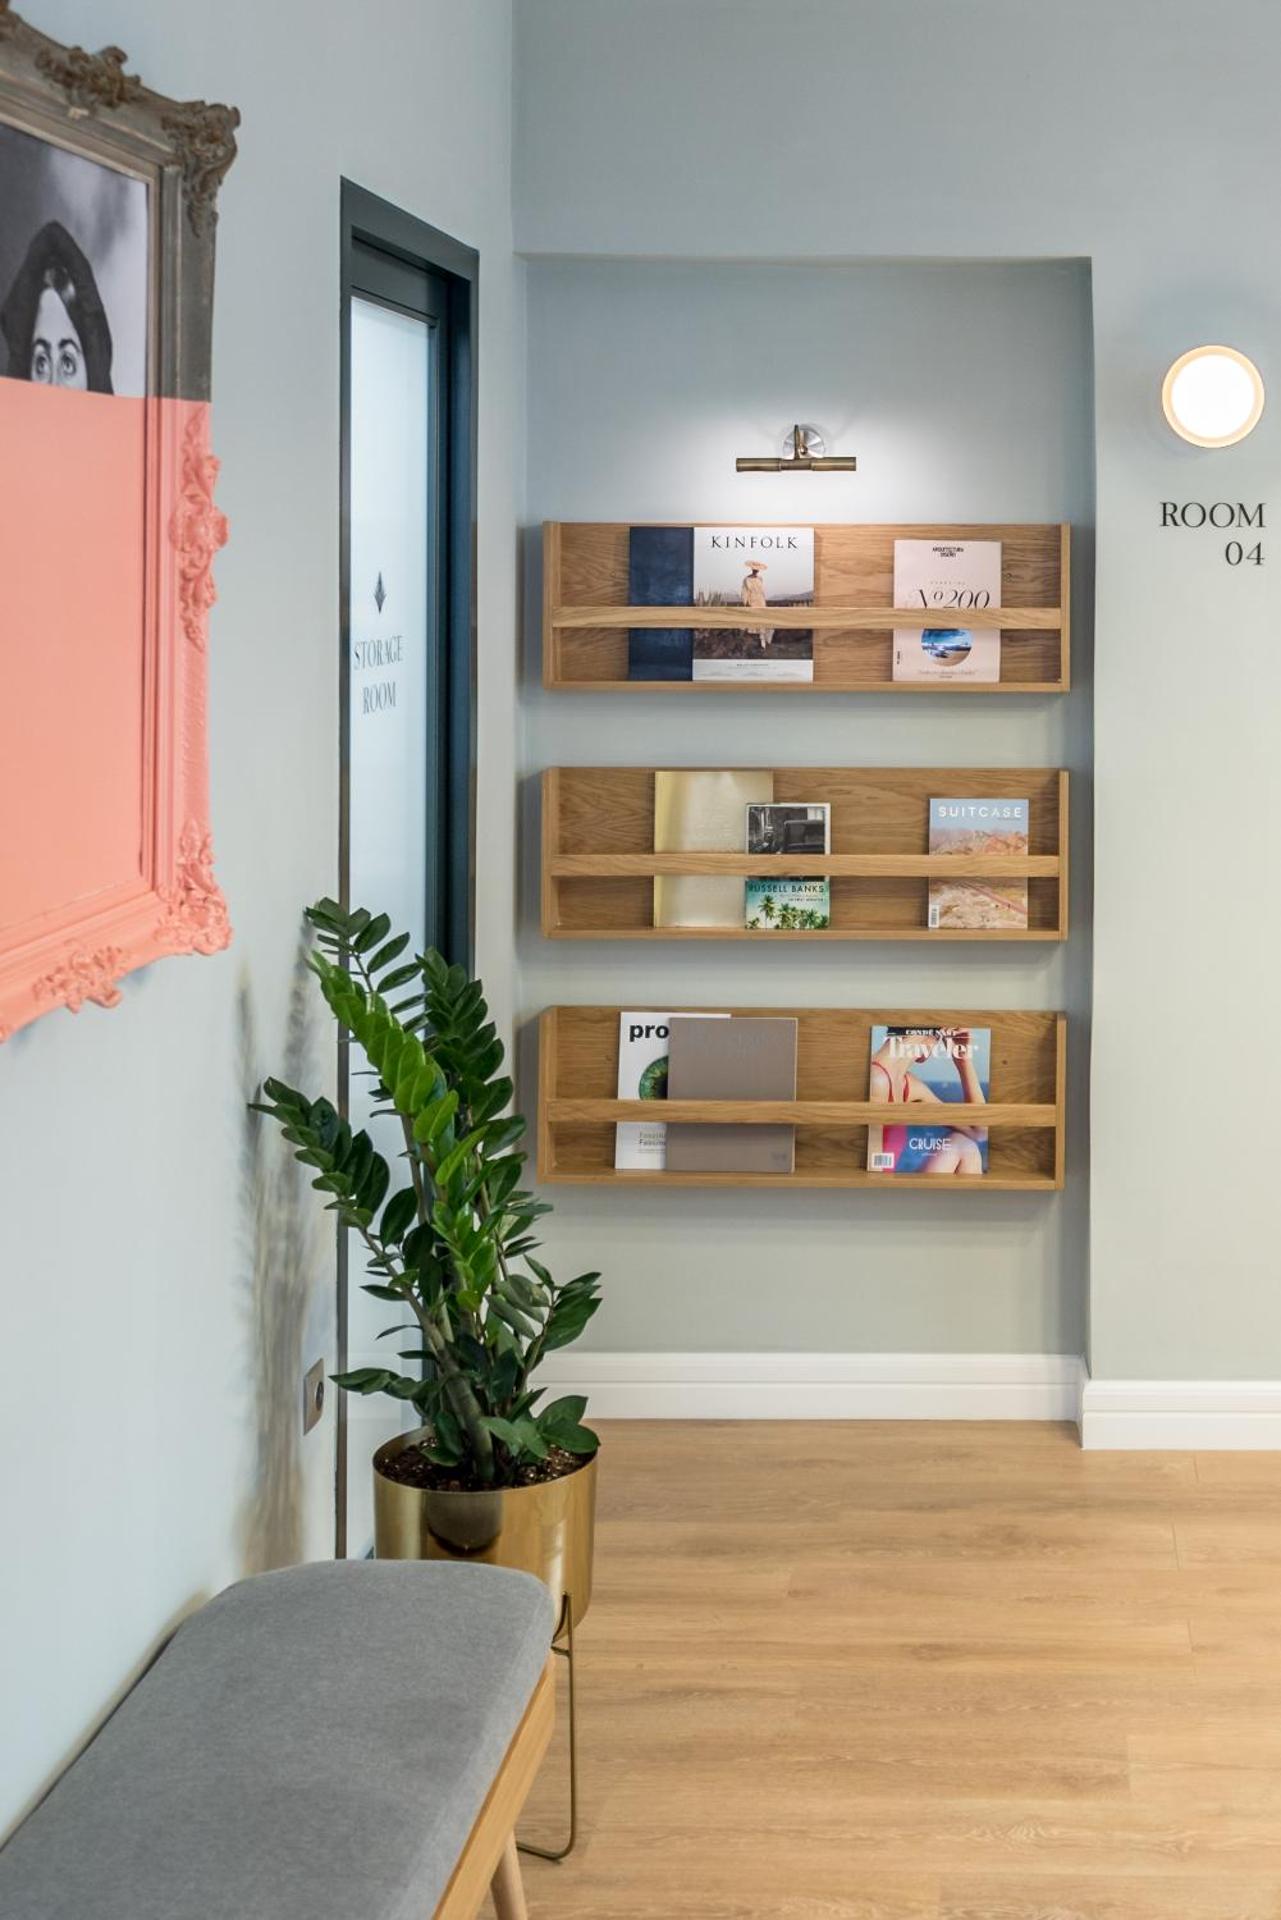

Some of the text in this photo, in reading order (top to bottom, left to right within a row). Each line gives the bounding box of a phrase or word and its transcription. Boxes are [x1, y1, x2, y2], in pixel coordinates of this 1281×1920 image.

[1160, 502, 1266, 528] ROOM
[711, 536, 799, 549] KINFOLK
[1225, 541, 1265, 566] 04
[354, 635, 403, 670] STORAGE
[363, 681, 396, 714] ROOM
[938, 806, 1022, 818] SUITCASE
[749, 884, 825, 893] RUSSELL BANKS
[629, 1024, 669, 1042] pro
[909, 1137, 952, 1150] CRUISE
